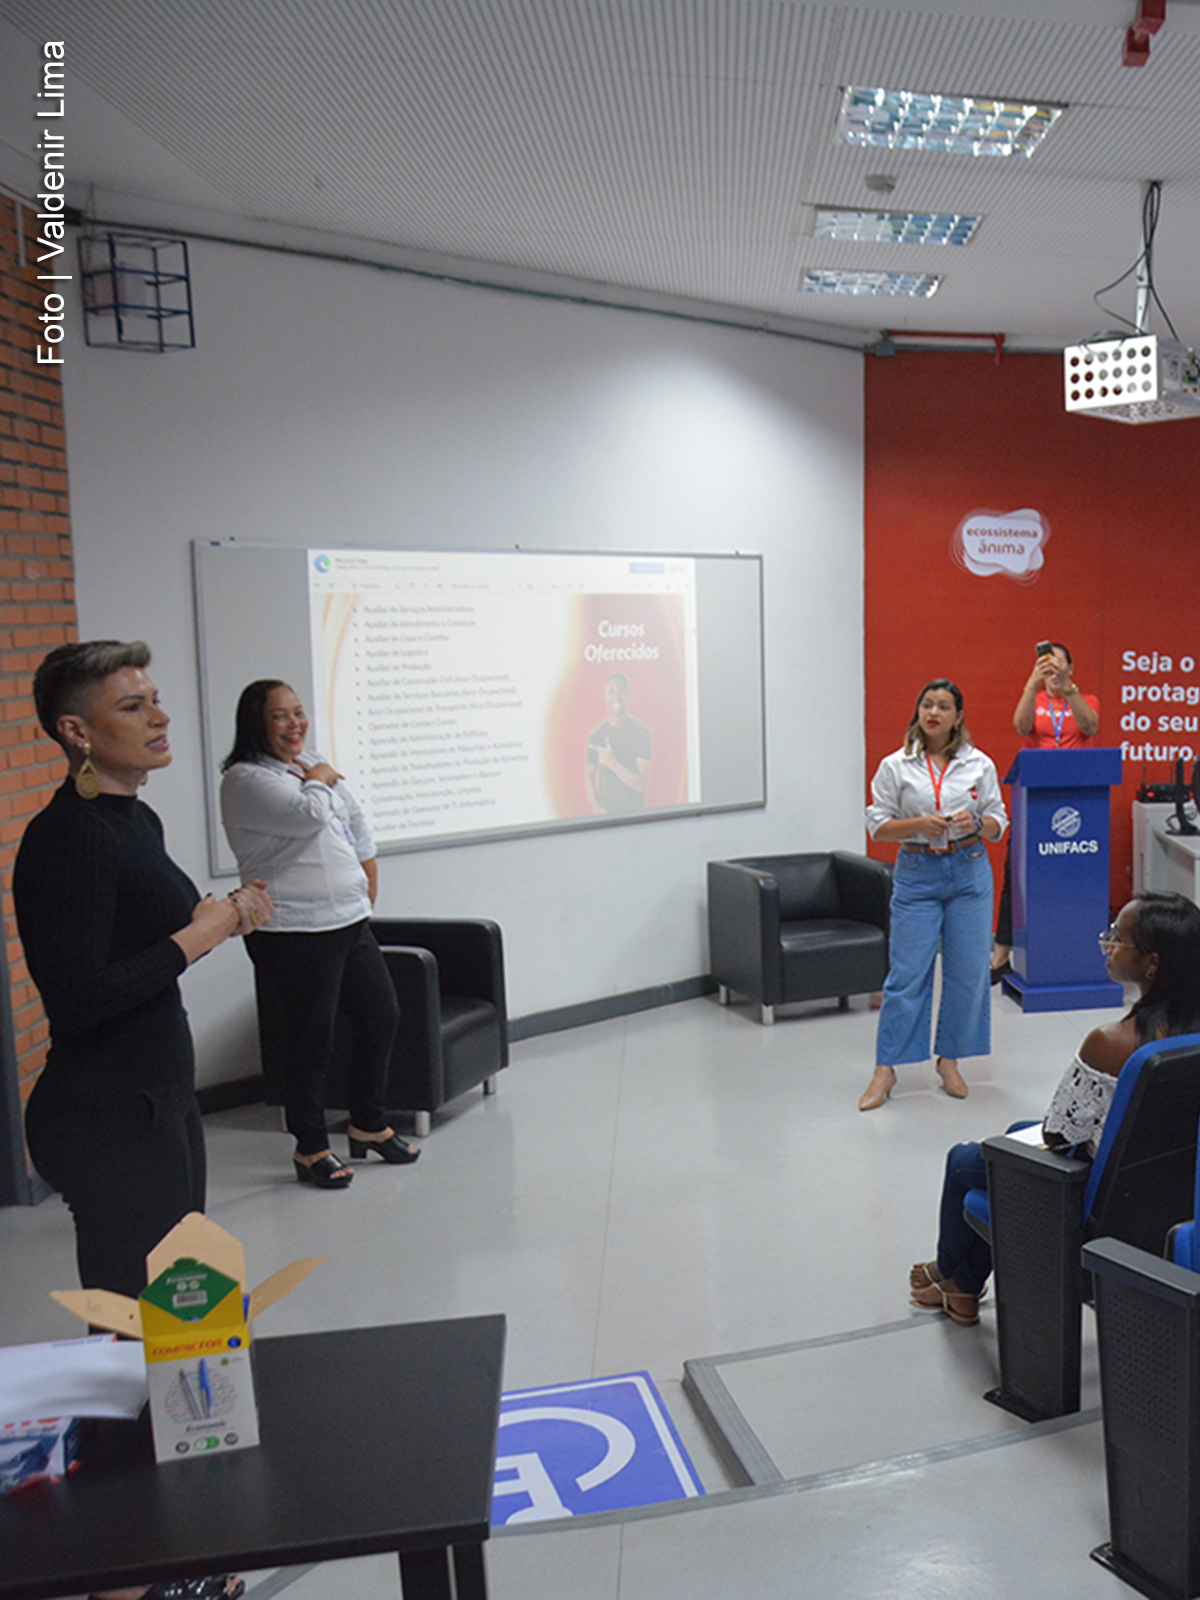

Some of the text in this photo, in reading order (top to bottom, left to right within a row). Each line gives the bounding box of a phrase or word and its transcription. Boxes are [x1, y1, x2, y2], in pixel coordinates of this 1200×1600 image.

[967, 526, 1038, 538] ecossistema
[598, 619, 645, 638] Cursos
[584, 642, 659, 664] Oferecidos
[1121, 650, 1195, 674] Seja o
[1120, 711, 1199, 732] do seu
[1038, 840, 1098, 855] UNIFACS
[152, 1339, 223, 1356] COMPACTOR
